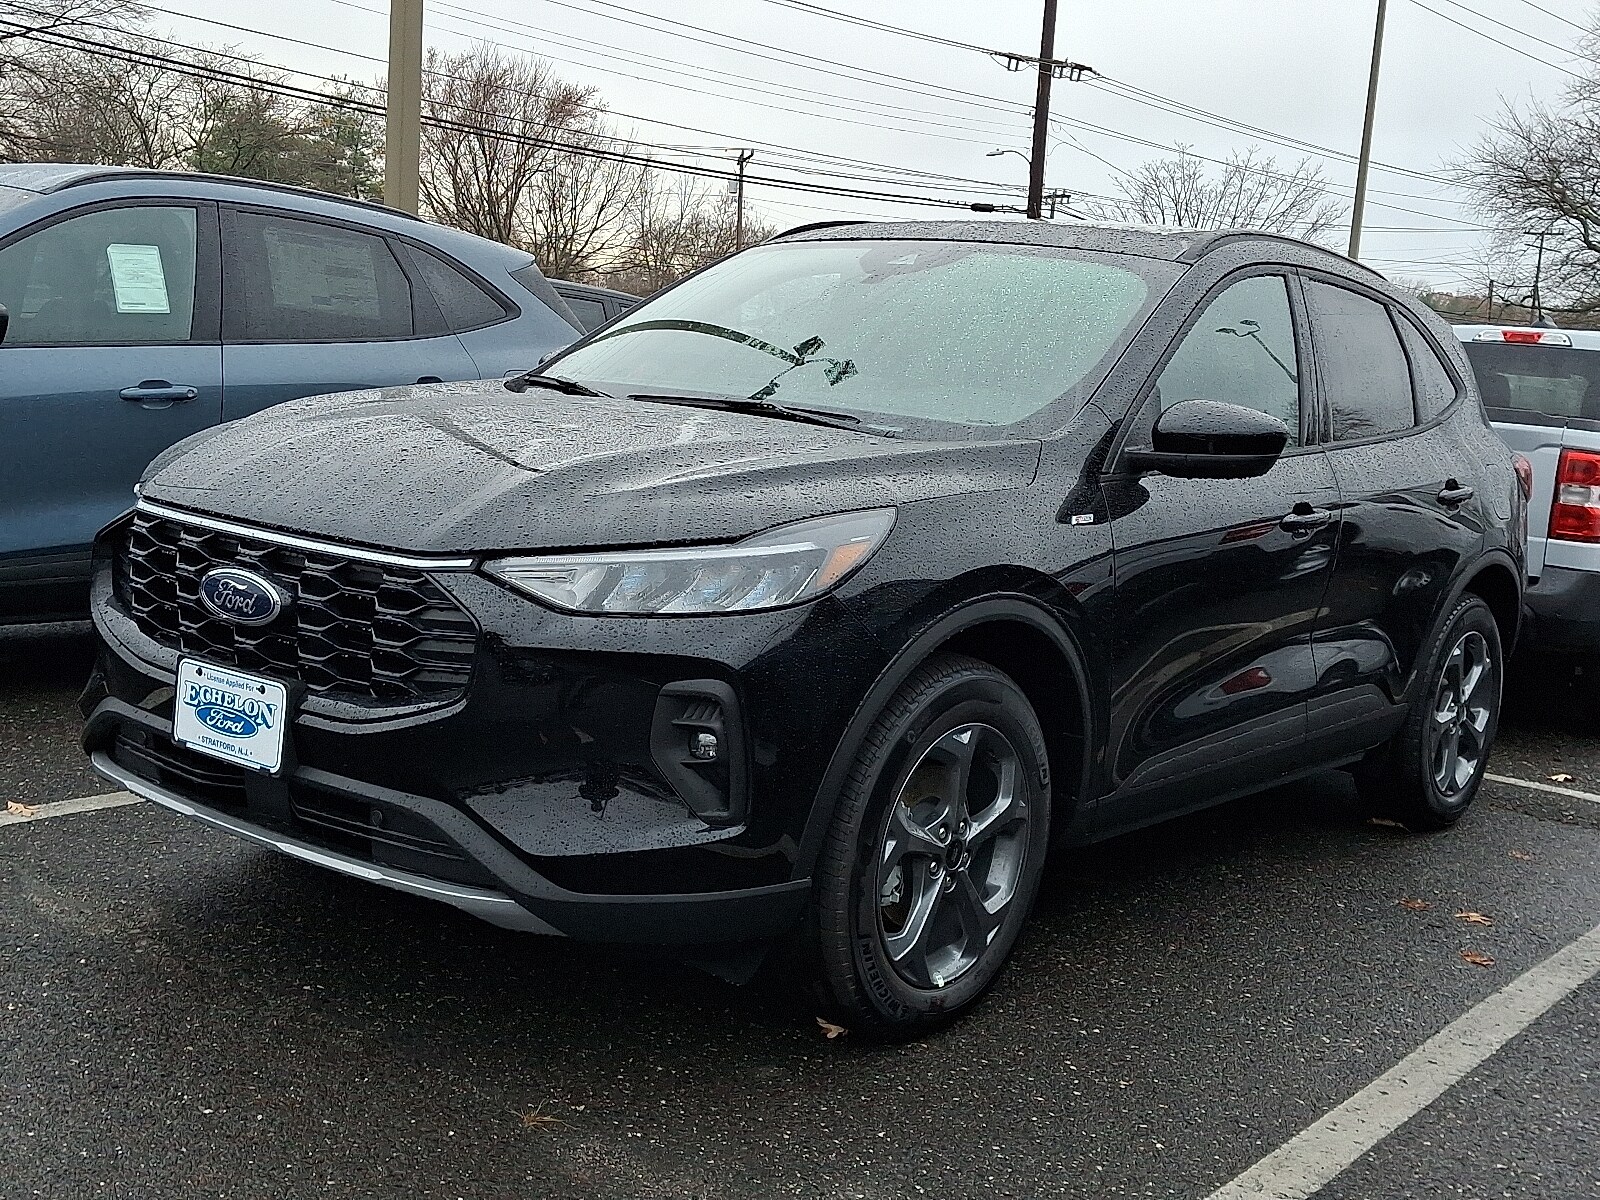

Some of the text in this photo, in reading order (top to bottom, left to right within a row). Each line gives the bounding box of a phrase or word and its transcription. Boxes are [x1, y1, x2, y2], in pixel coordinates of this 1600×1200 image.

[213, 578, 258, 614] Ford
[206, 672, 255, 692] License Applied For
[183, 680, 278, 729] ECHELON
[207, 708, 245, 733] Ford
[201, 735, 249, 756] STRATFORD, N.J.
